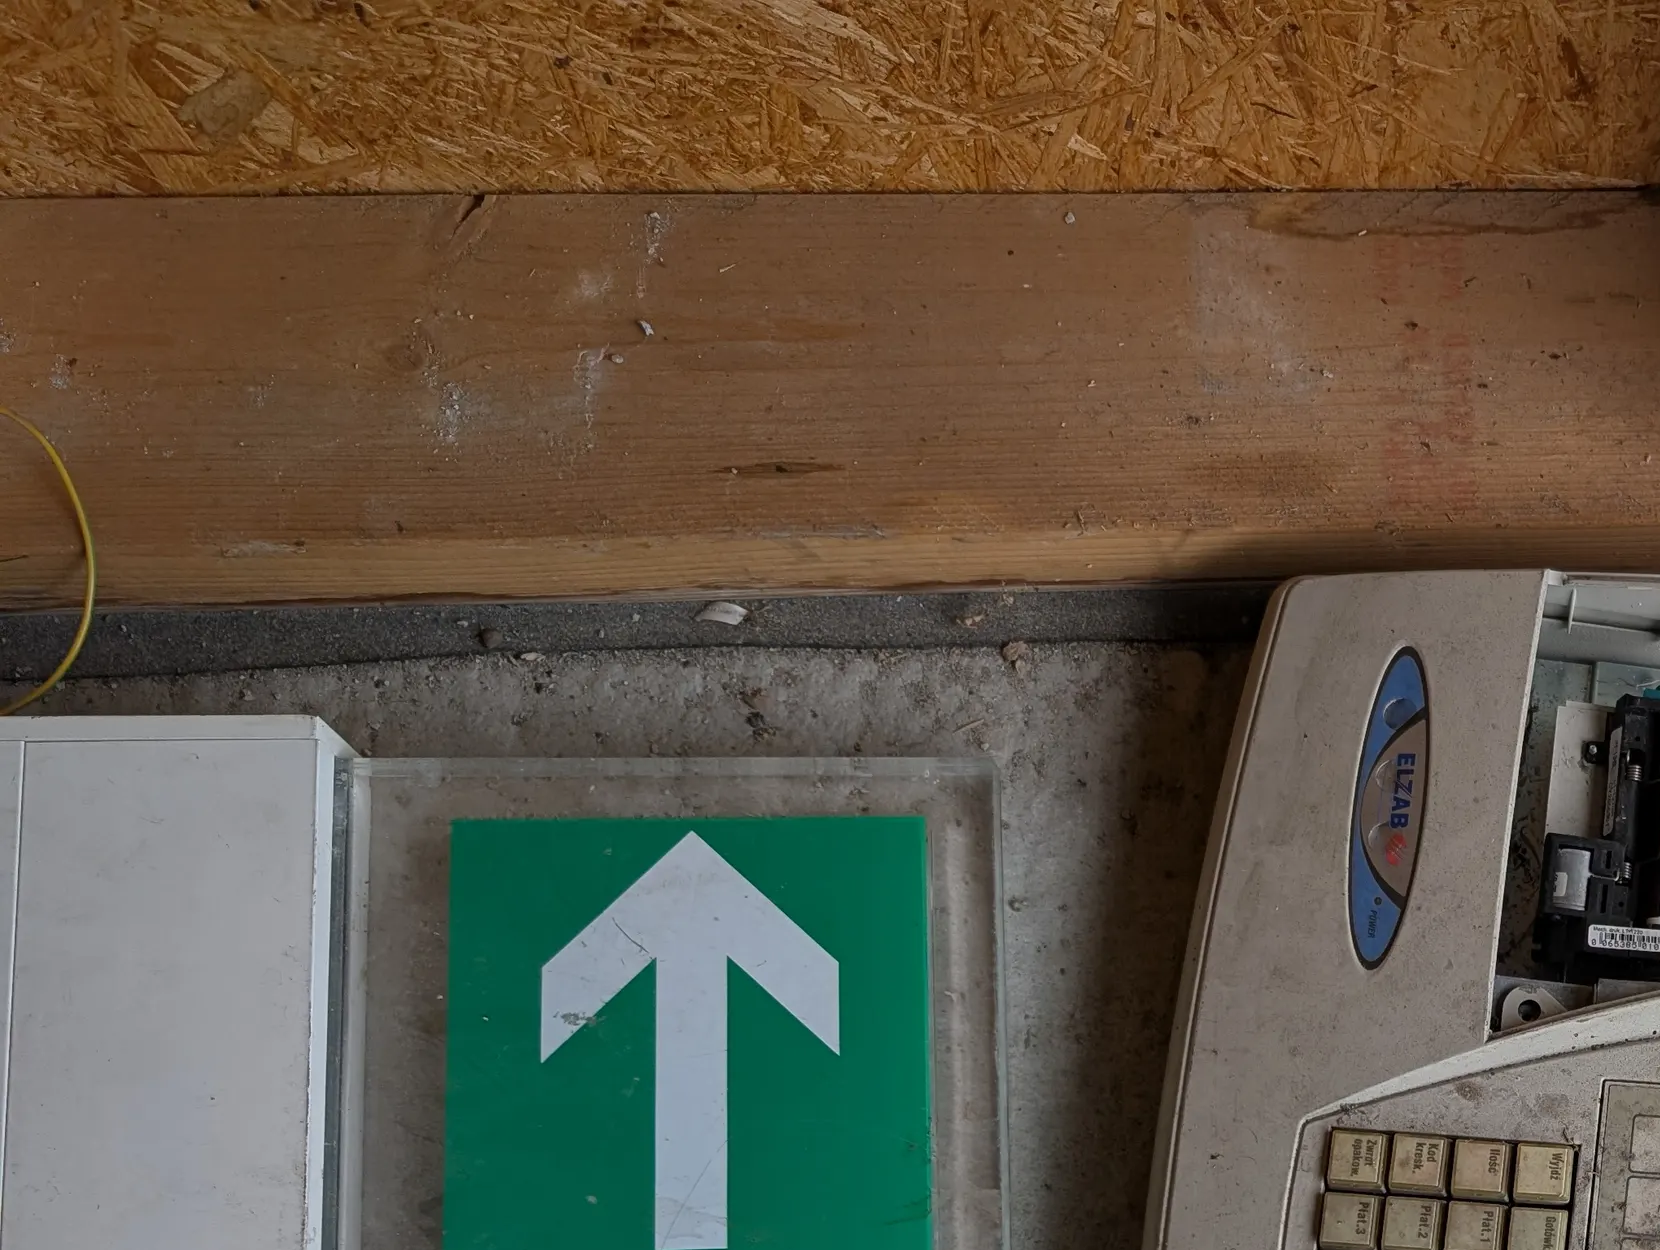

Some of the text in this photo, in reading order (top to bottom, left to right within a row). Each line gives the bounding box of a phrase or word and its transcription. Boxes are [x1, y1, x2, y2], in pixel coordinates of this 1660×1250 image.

[1389, 753, 1416, 829] ELZAB
[1367, 910, 1378, 939] POWER
[1350, 1138, 1363, 1177] opakow.
[1363, 1139, 1377, 1167] Zwrot
[1411, 1142, 1427, 1174] kresk.
[1427, 1143, 1440, 1164] Kod
